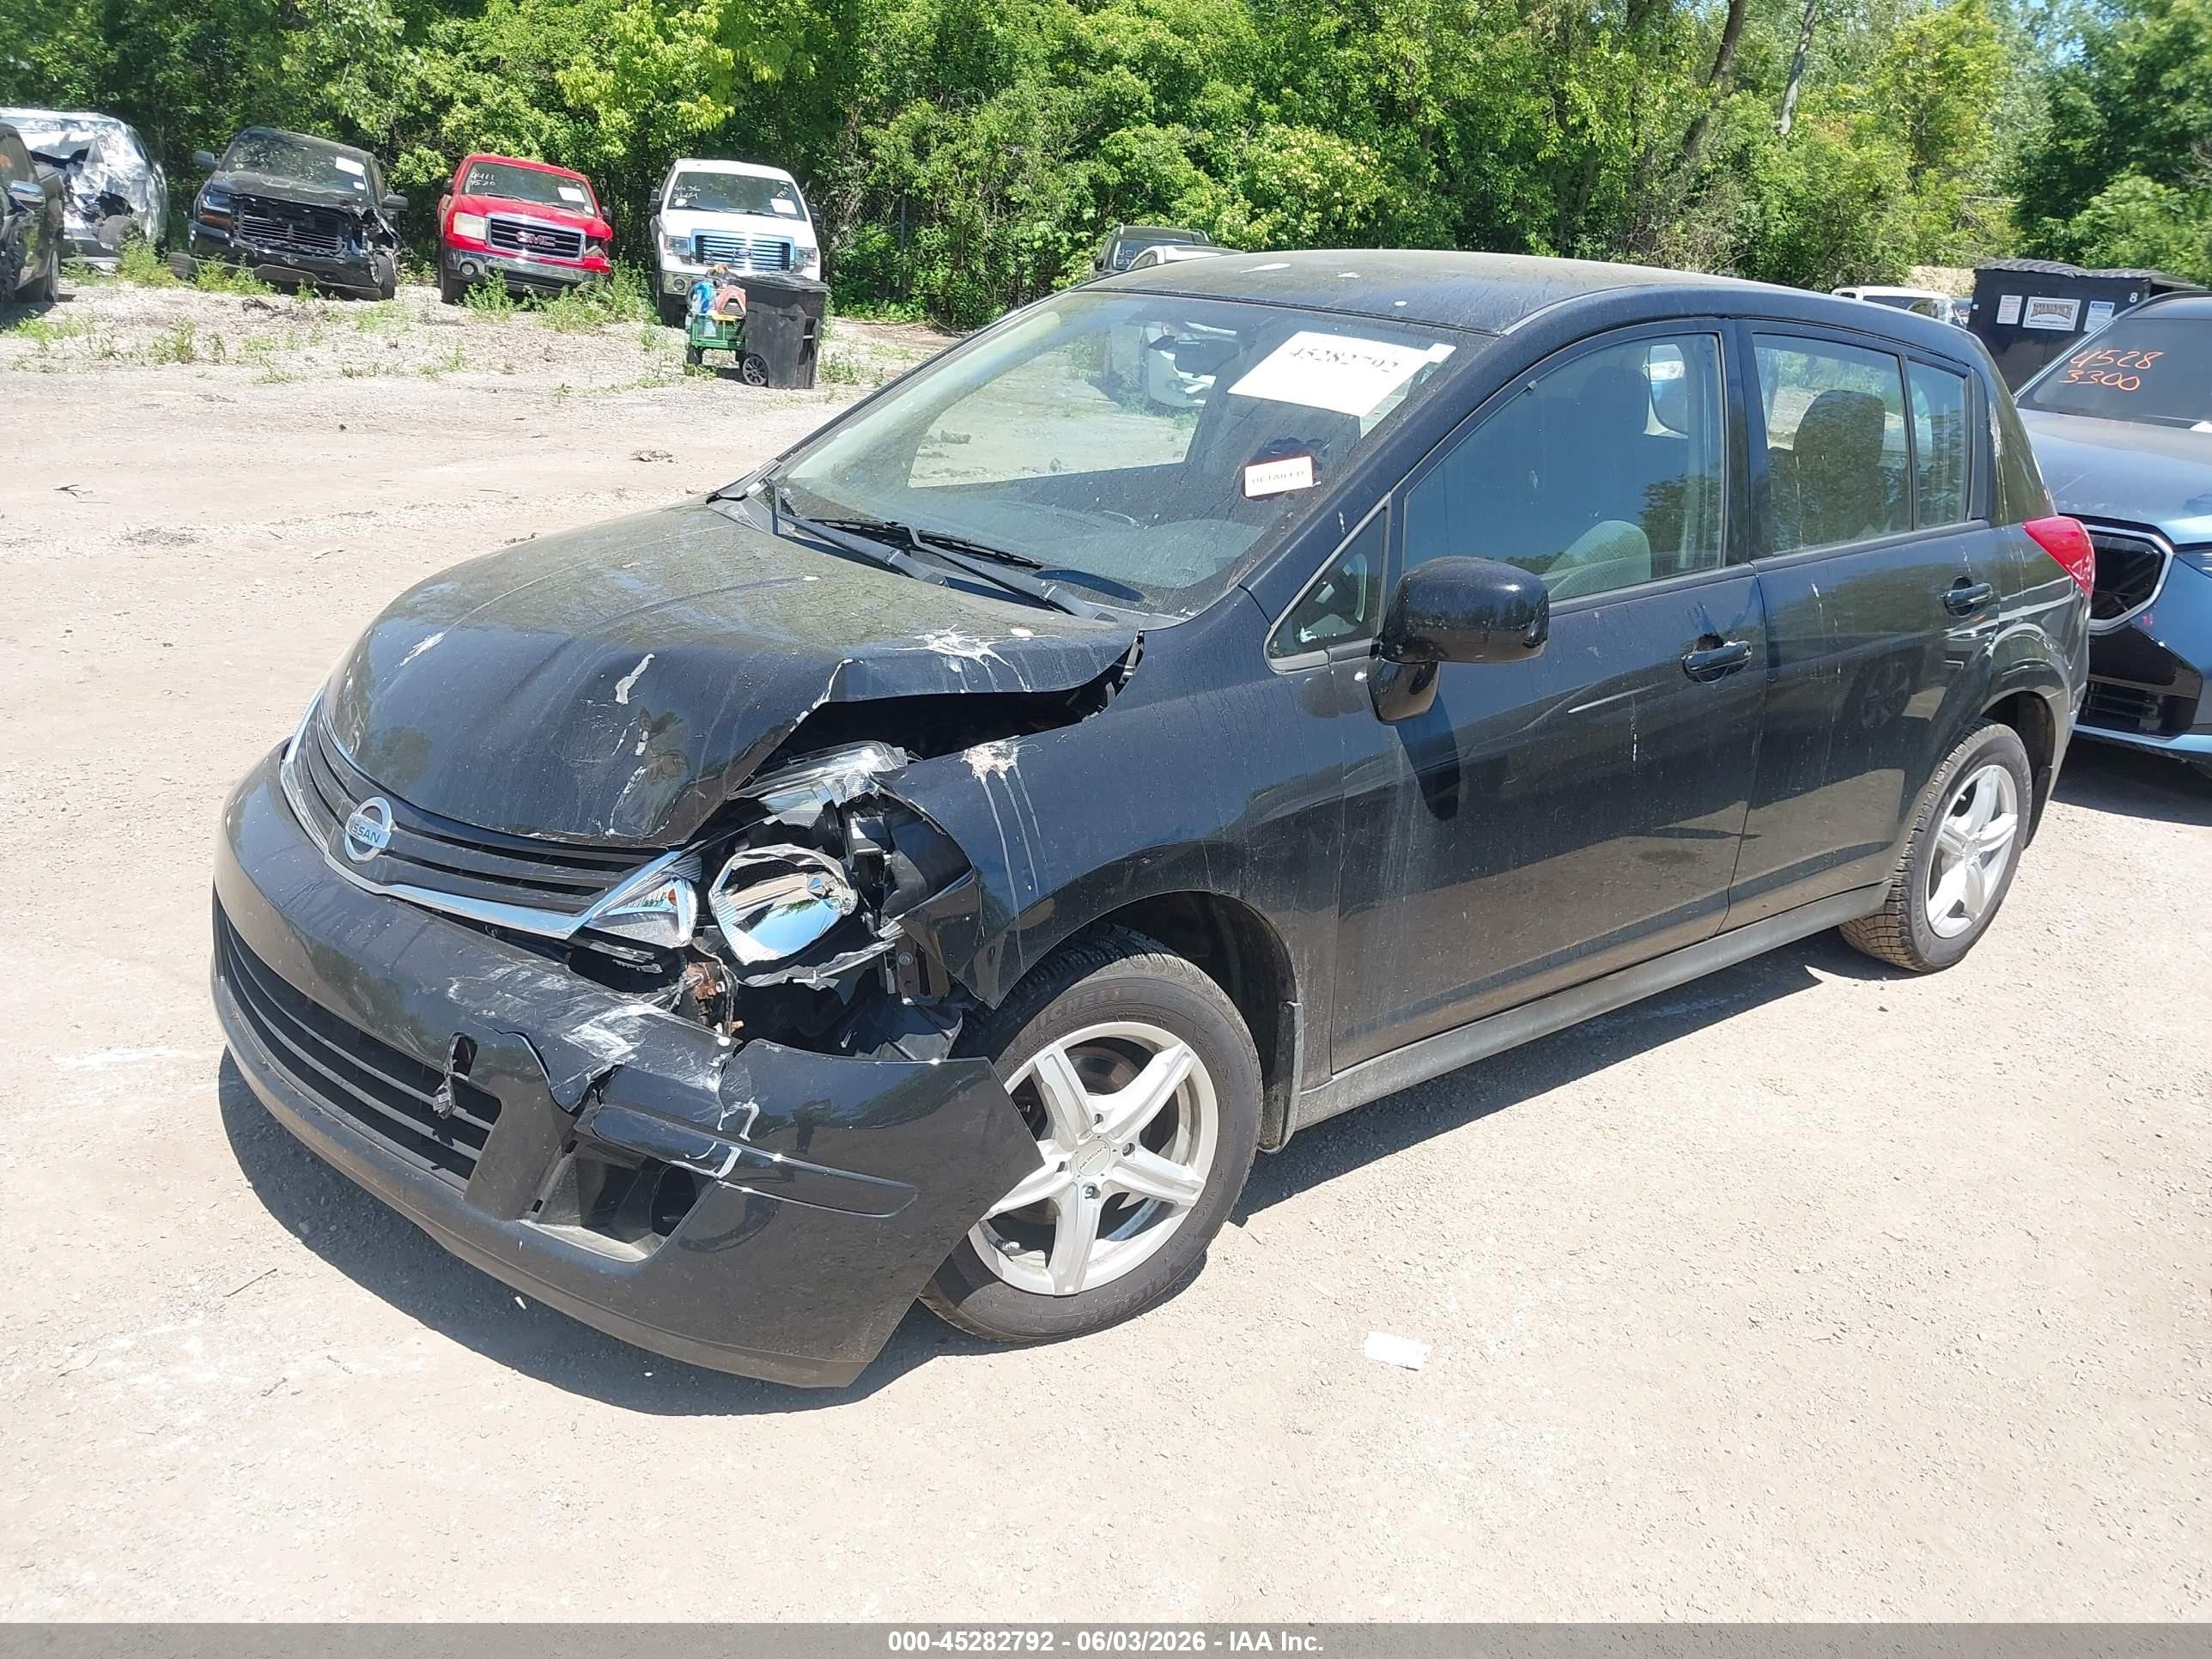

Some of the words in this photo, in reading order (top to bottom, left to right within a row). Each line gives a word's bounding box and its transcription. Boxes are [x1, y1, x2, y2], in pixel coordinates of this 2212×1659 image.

[516, 230, 556, 247] GMC
[2129, 292, 2138, 303] 8
[2069, 348, 2164, 368] 4528
[2057, 369, 2141, 391] 3300
